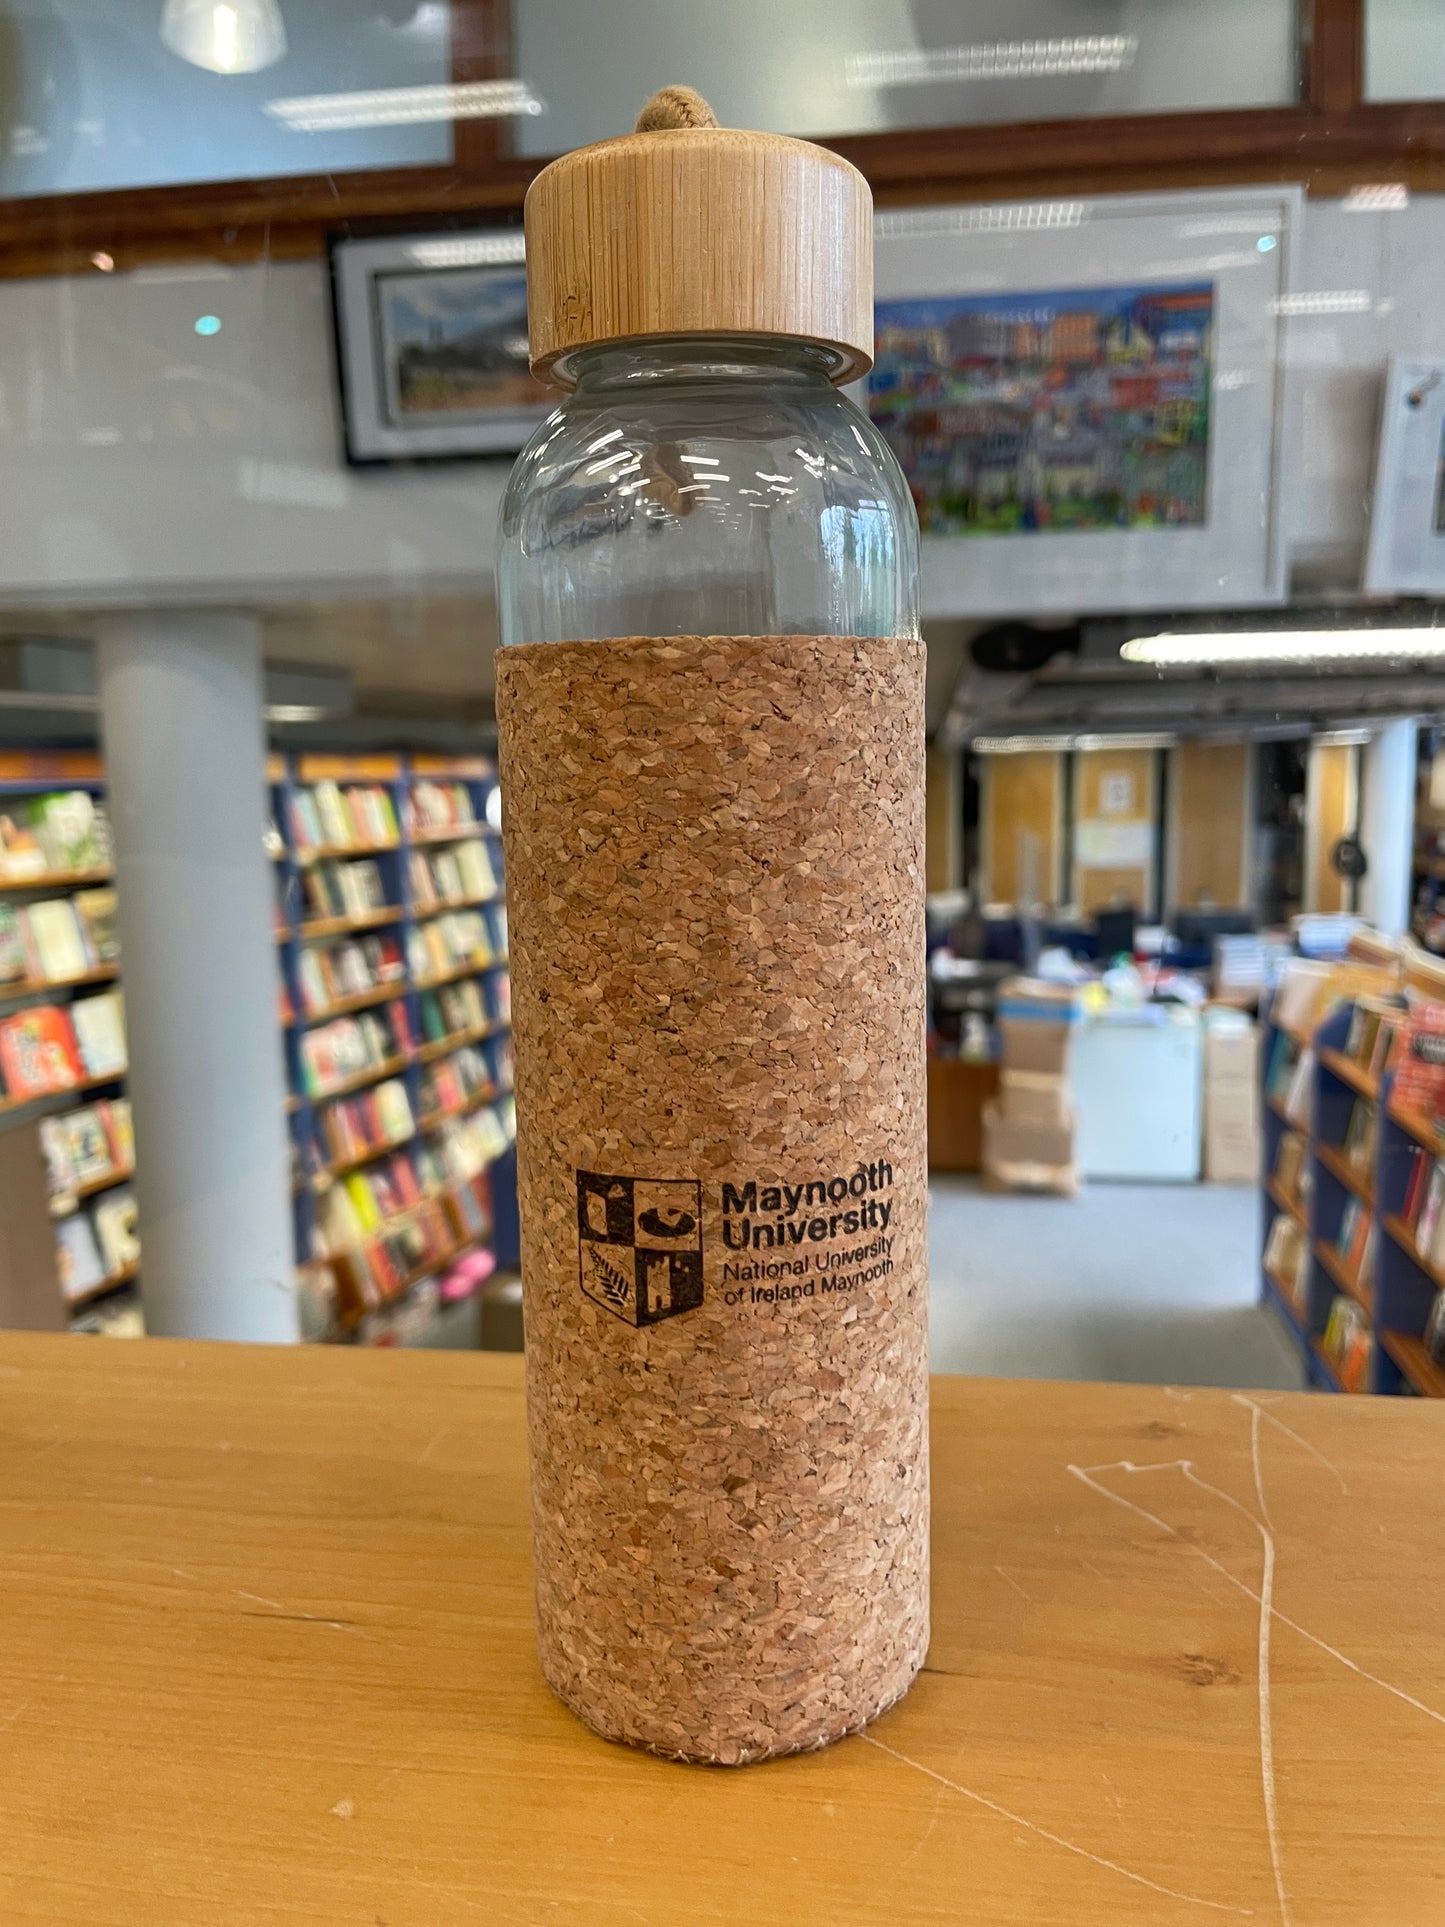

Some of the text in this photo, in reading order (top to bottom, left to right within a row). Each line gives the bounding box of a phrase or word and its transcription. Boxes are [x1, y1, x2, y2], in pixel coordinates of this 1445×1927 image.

[722, 1159, 893, 1215] Maynooth
[723, 1198, 893, 1250] University
[724, 1236, 893, 1281] National University
[724, 1259, 894, 1306] of Ireland Maynooth
